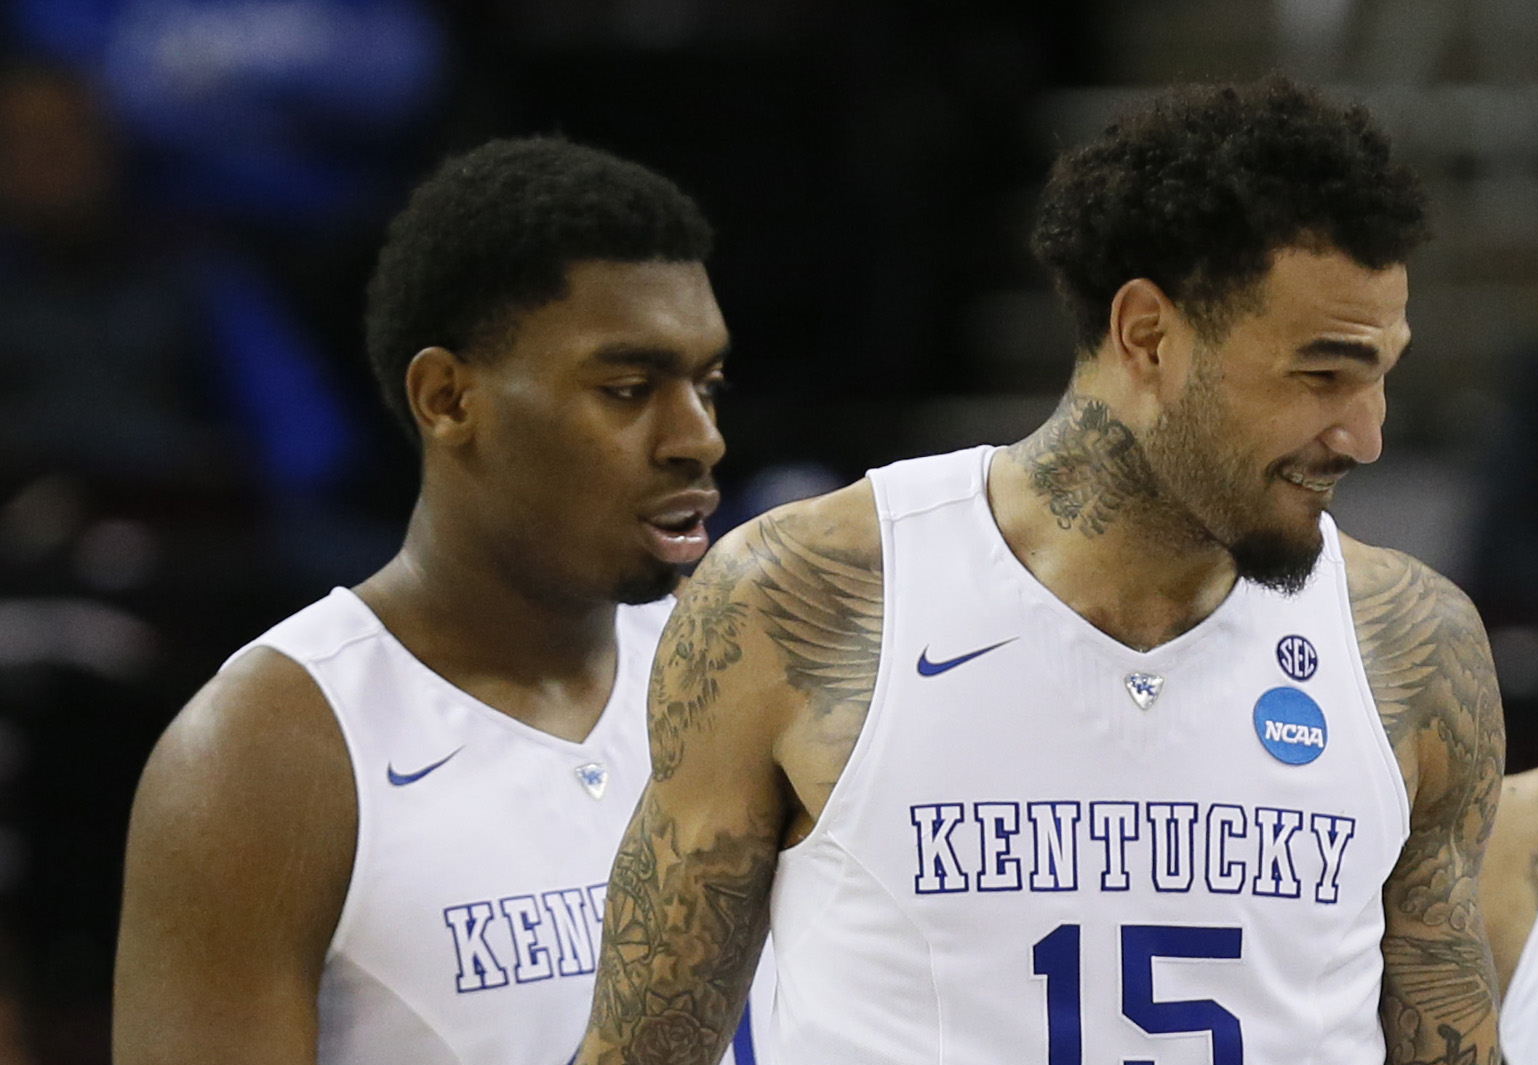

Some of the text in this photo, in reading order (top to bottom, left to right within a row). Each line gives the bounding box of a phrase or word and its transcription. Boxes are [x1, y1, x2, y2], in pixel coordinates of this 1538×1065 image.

[1278, 636, 1317, 680] SEC
[1265, 720, 1324, 748] NCAA
[910, 801, 1355, 904] KENTUCKY
